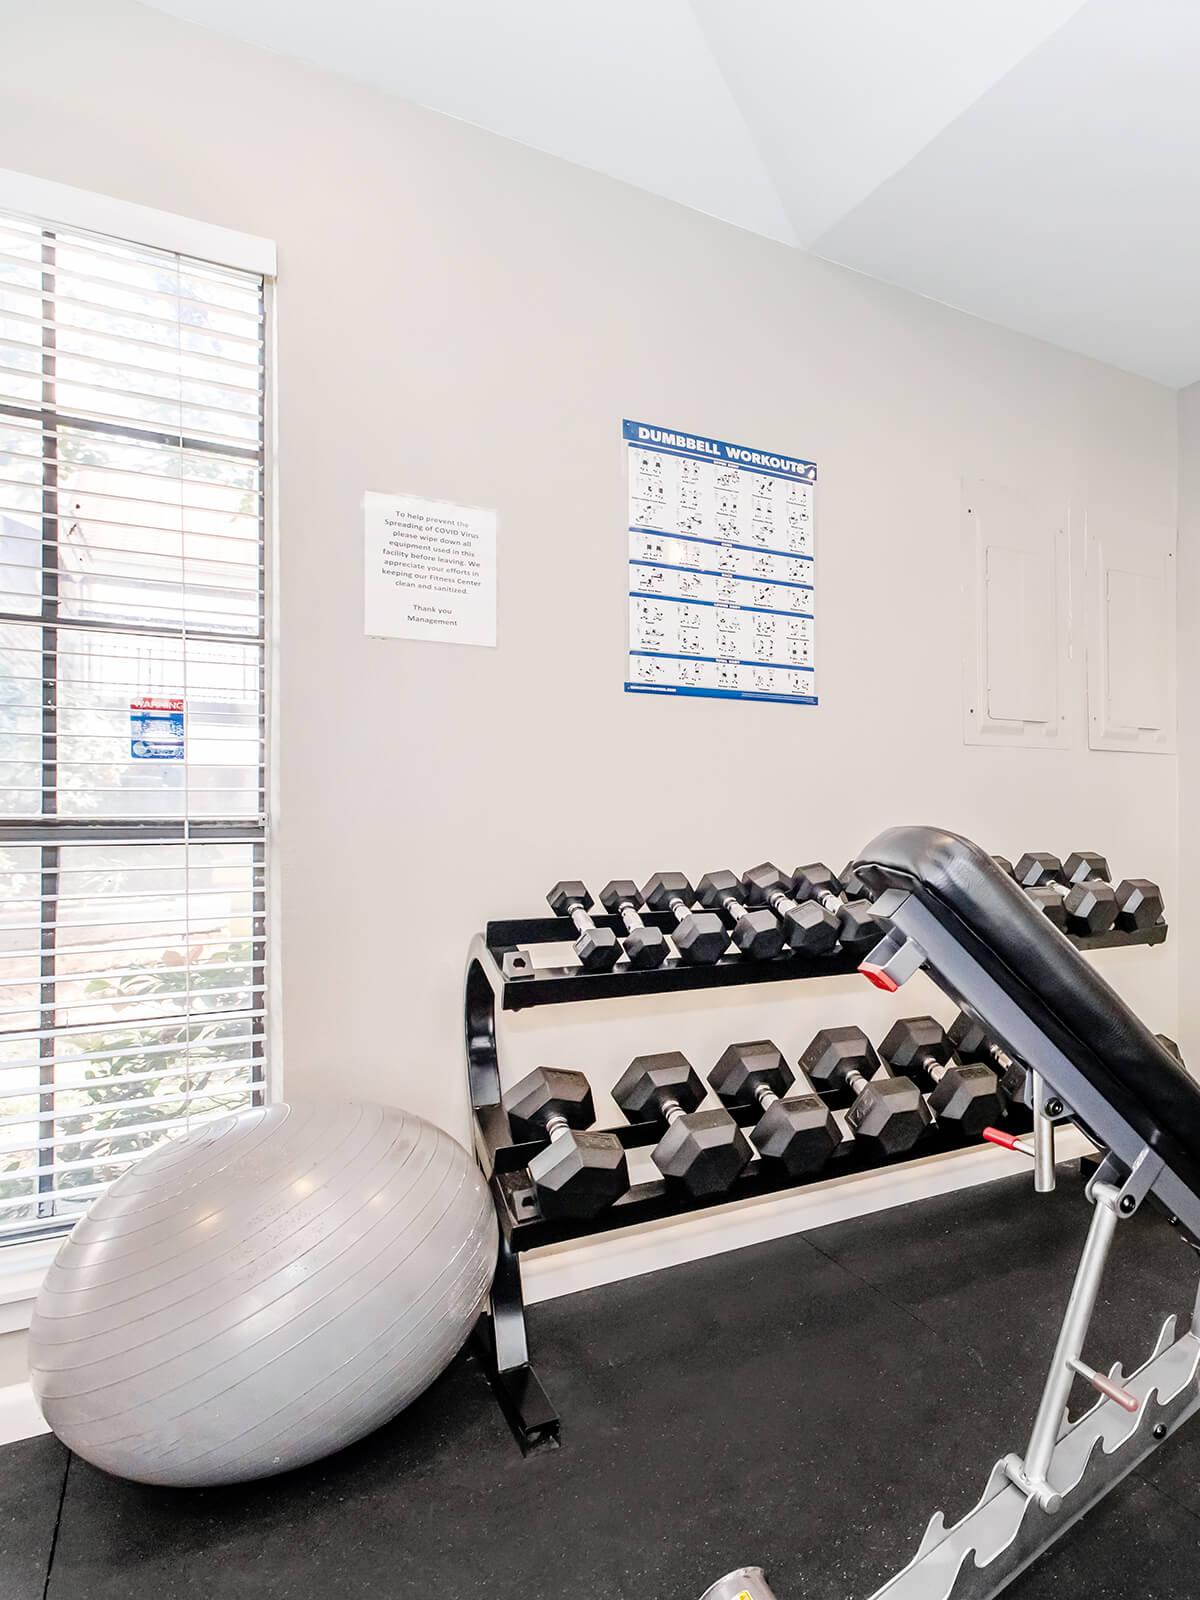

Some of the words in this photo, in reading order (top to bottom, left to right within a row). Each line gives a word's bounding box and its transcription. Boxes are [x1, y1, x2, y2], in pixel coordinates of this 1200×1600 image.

[638, 427, 721, 456] DUMBBELL
[725, 446, 805, 474] WORKOUTS
[384, 518, 424, 532] Spreading
[425, 525, 434, 533] of
[434, 526, 459, 537] COVID
[460, 531, 480, 540] Virus
[395, 510, 406, 519] To
[407, 512, 424, 522] help
[425, 516, 455, 527] prevent
[456, 519, 470, 529] the
[388, 539, 431, 553] equipment
[433, 545, 451, 555] used
[461, 549, 475, 558] this
[393, 530, 418, 541] please
[419, 535, 438, 544] wipe
[439, 537, 461, 547] down
[462, 540, 472, 548] all
[382, 548, 409, 559] facility
[410, 552, 436, 563] before
[437, 555, 466, 567] leaving.
[468, 560, 481, 568] We
[381, 568, 413, 580] keeping
[414, 573, 428, 581] our
[429, 573, 456, 584] Fitness
[457, 577, 482, 587] Center
[383, 559, 425, 572] appreciate
[426, 565, 445, 573] your
[446, 567, 471, 577] efforts
[395, 579, 416, 589] clean
[417, 582, 432, 591] and
[413, 604, 436, 614] Thank
[437, 607, 453, 616] you
[407, 615, 458, 627] Management
